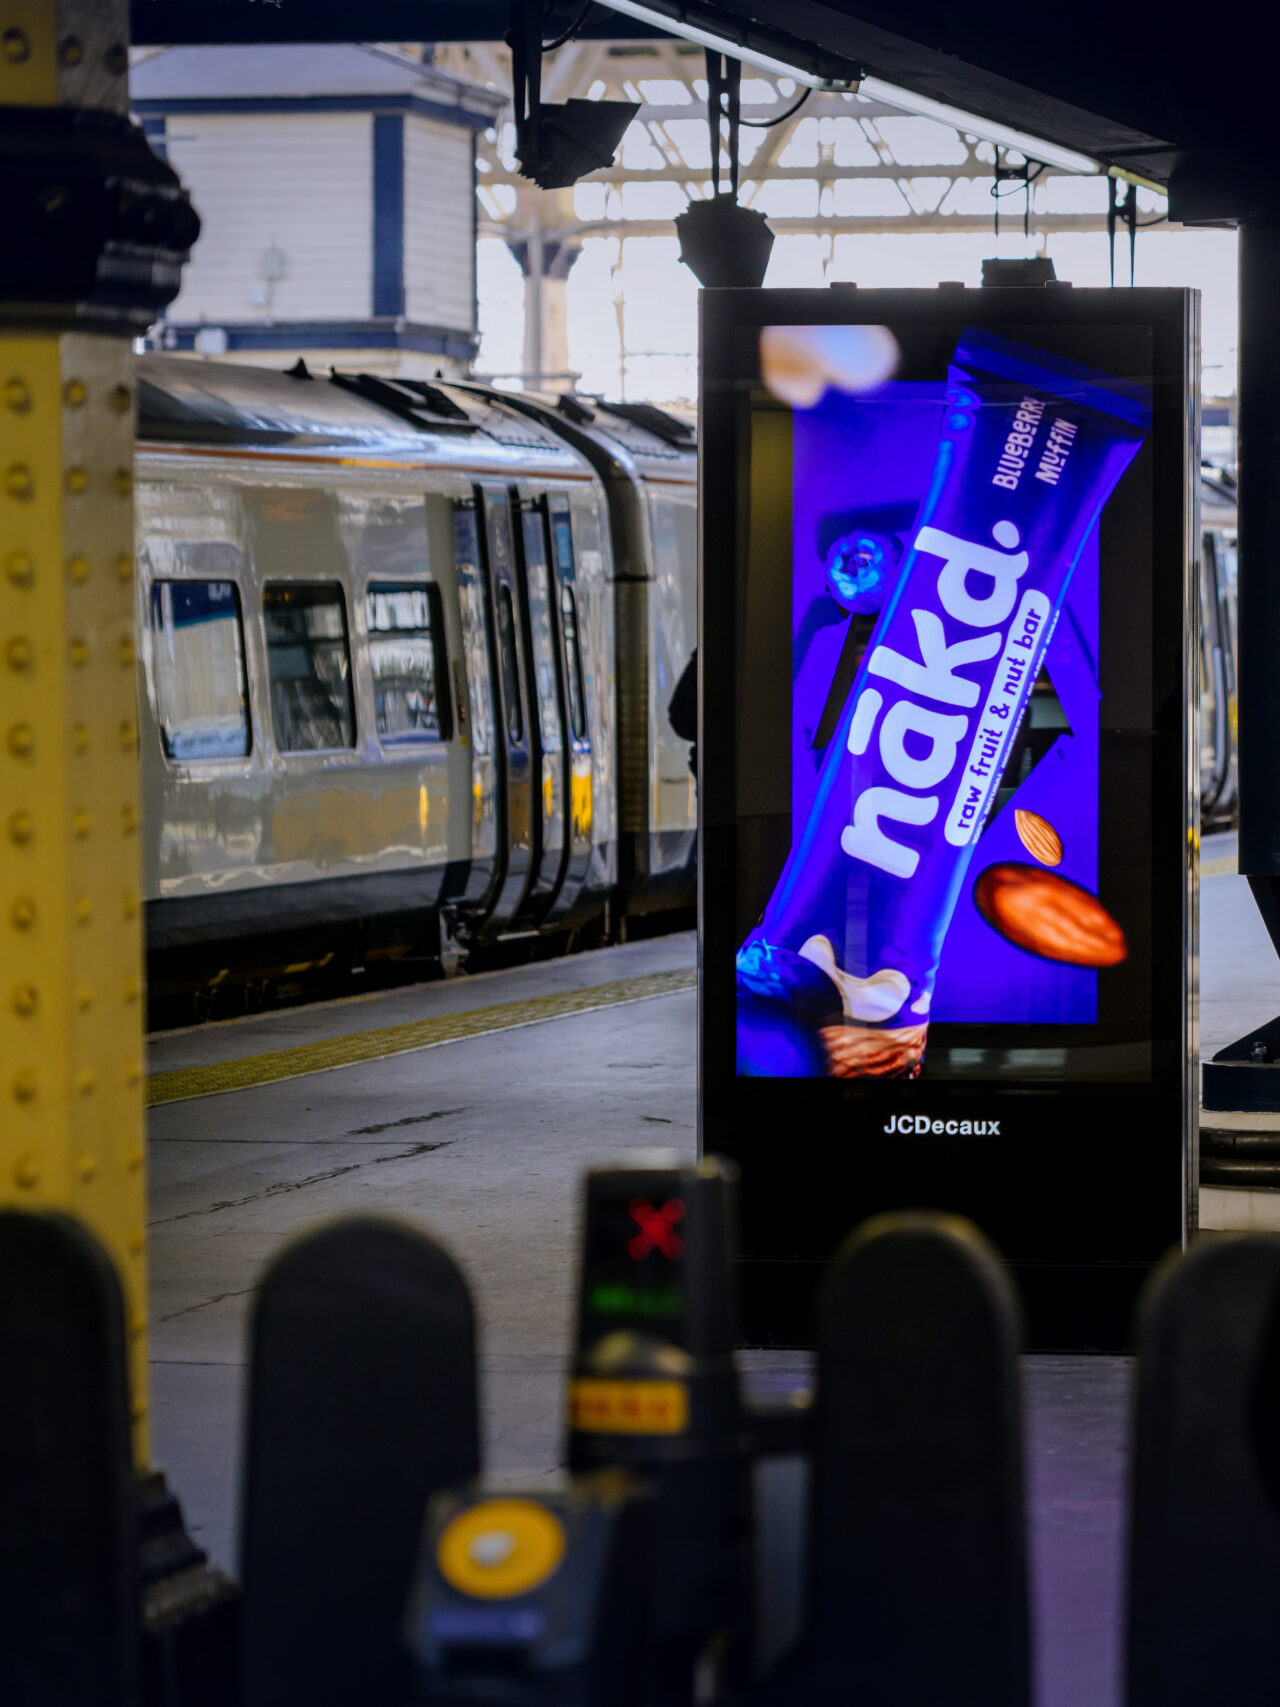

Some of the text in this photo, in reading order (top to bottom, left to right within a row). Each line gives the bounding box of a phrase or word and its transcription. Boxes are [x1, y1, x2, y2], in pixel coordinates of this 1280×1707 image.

[840, 520, 1029, 879] nākd.
[957, 608, 1041, 829] raw fruit & nut bar
[883, 1114, 1001, 1136] JCDecaux
